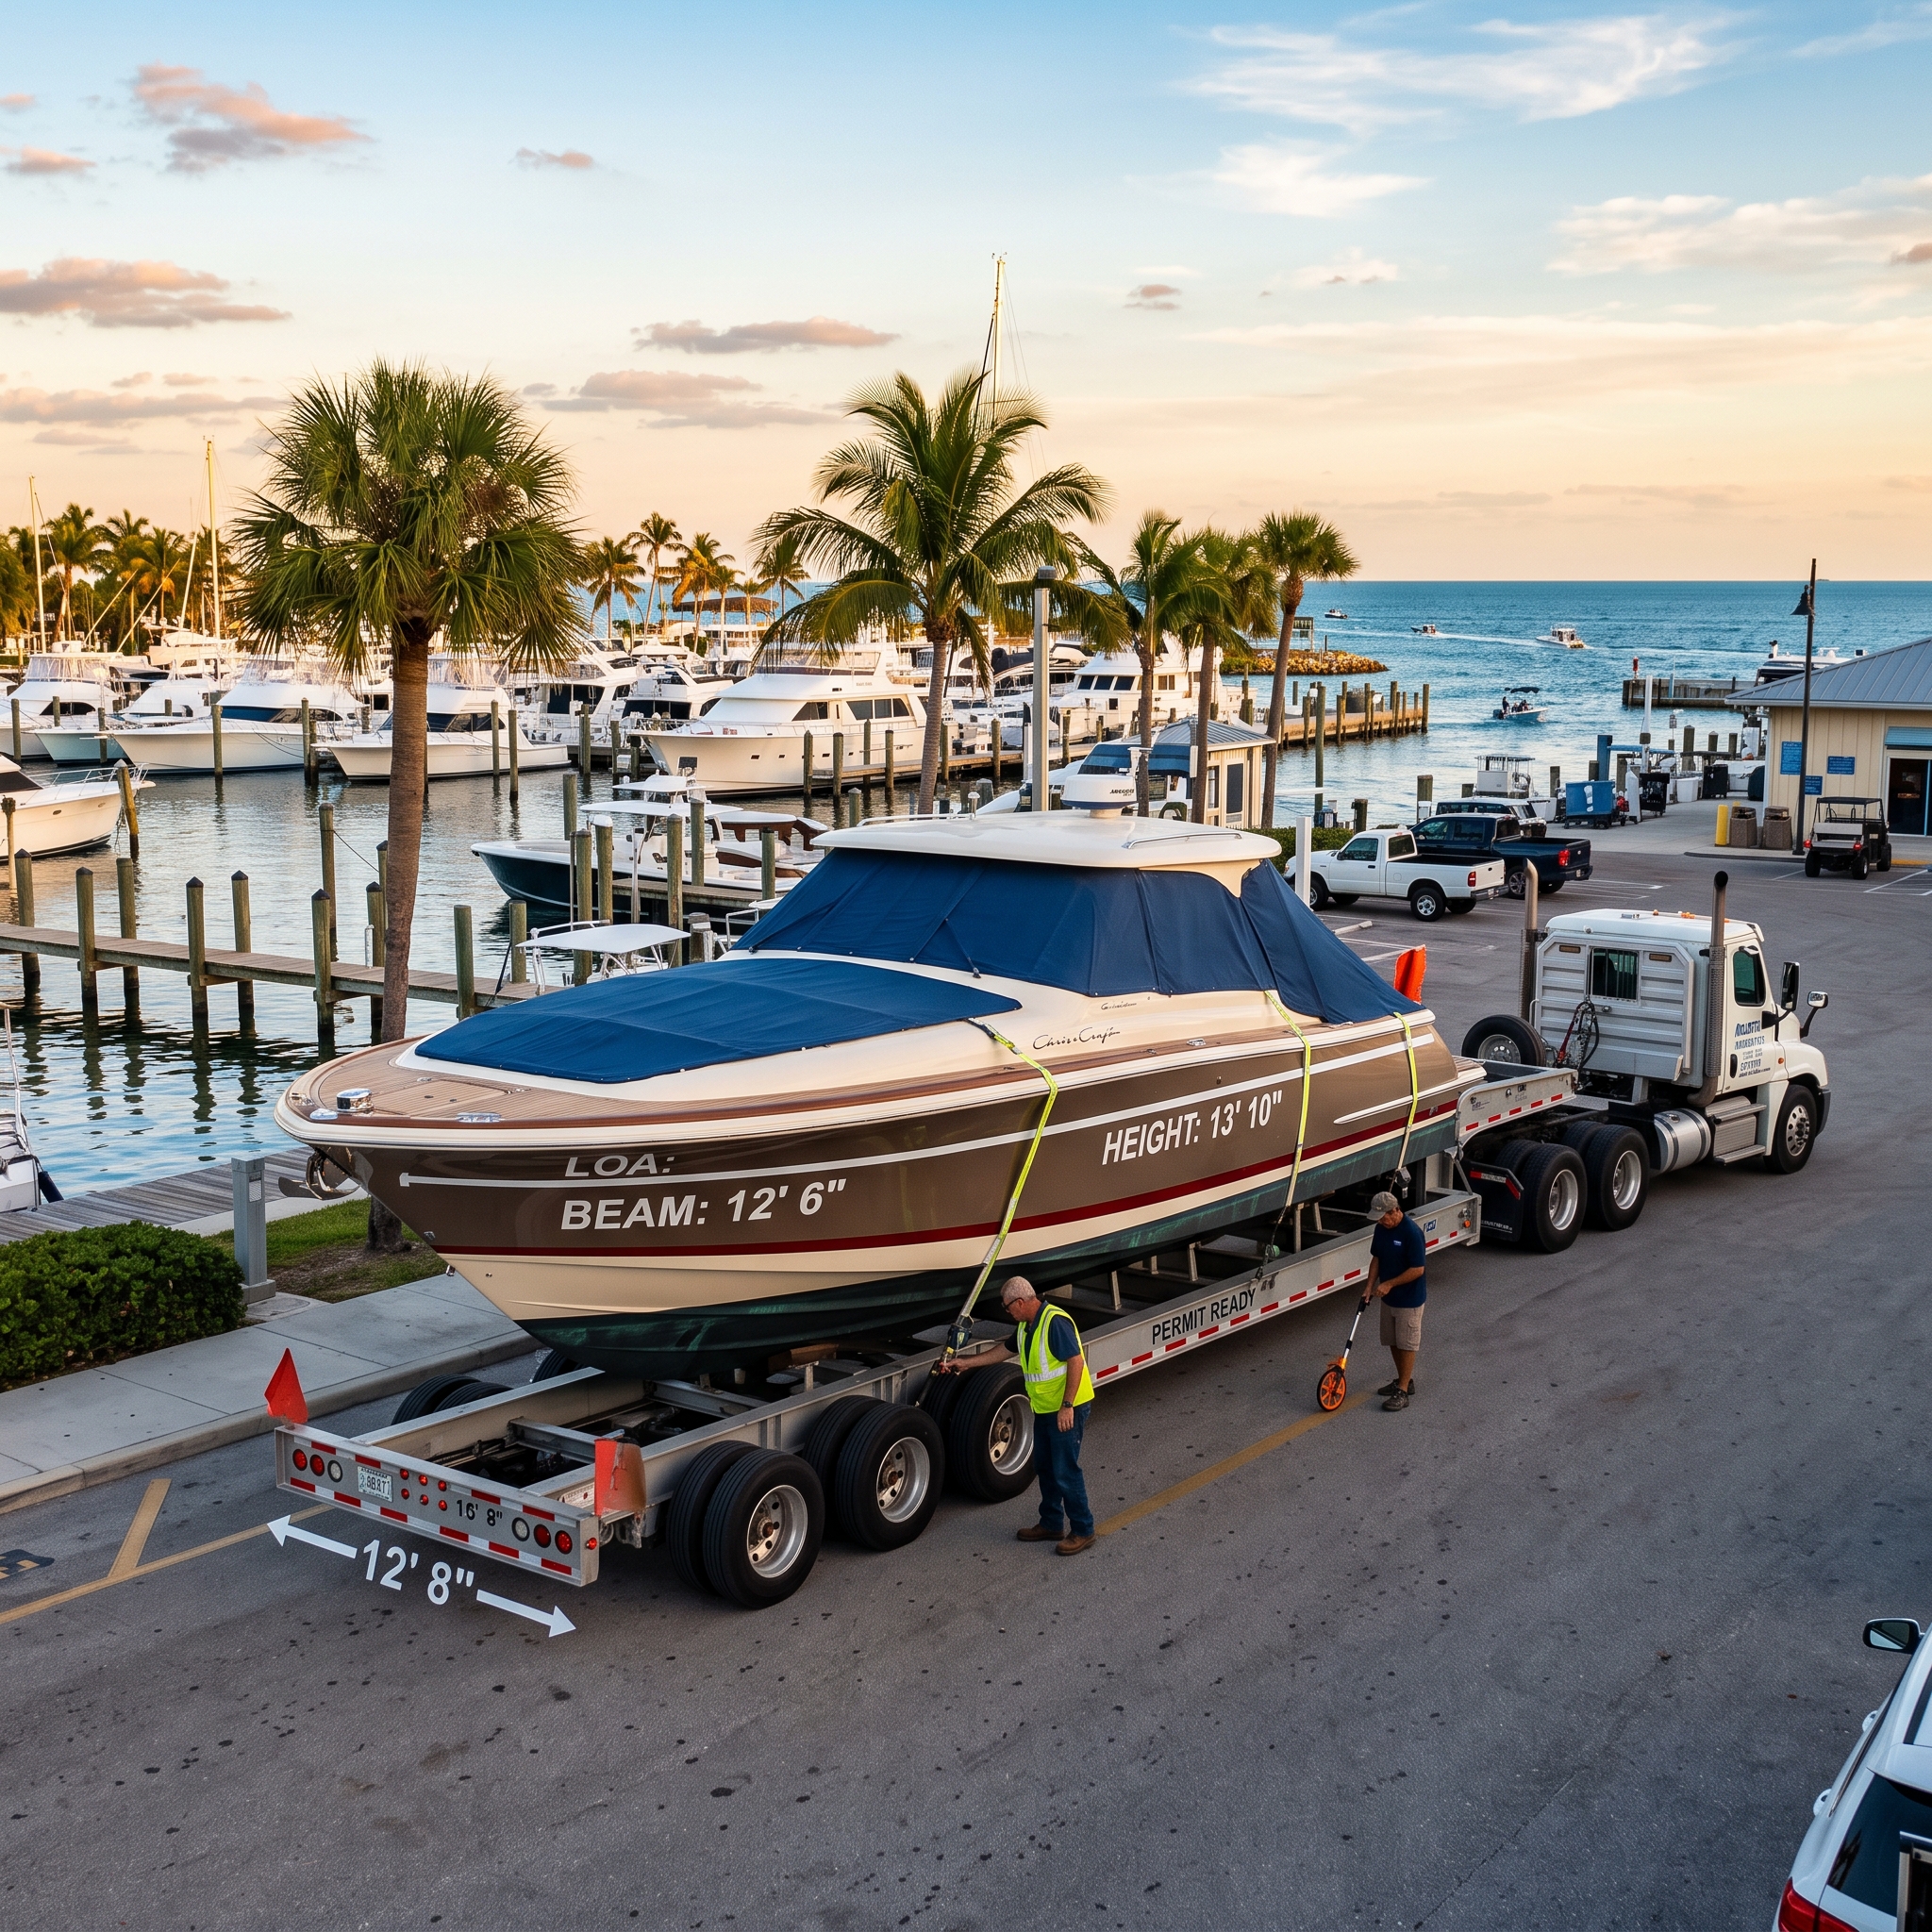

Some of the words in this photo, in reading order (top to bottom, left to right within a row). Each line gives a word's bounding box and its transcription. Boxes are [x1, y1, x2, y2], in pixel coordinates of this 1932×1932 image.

[1102, 1112, 1201, 1165] HEIGHT:
[1210, 1100, 1241, 1140] 13'
[1247, 1090, 1283, 1129] 10"
[564, 1153, 675, 1177] LOA:
[560, 1194, 709, 1230] BEAM:
[727, 1185, 789, 1223] 12'
[799, 1178, 847, 1216] 6"
[1152, 1304, 1206, 1345] PERMIT
[1210, 1289, 1257, 1323] READY
[456, 1499, 478, 1521] 16'
[487, 1507, 503, 1527] 8"
